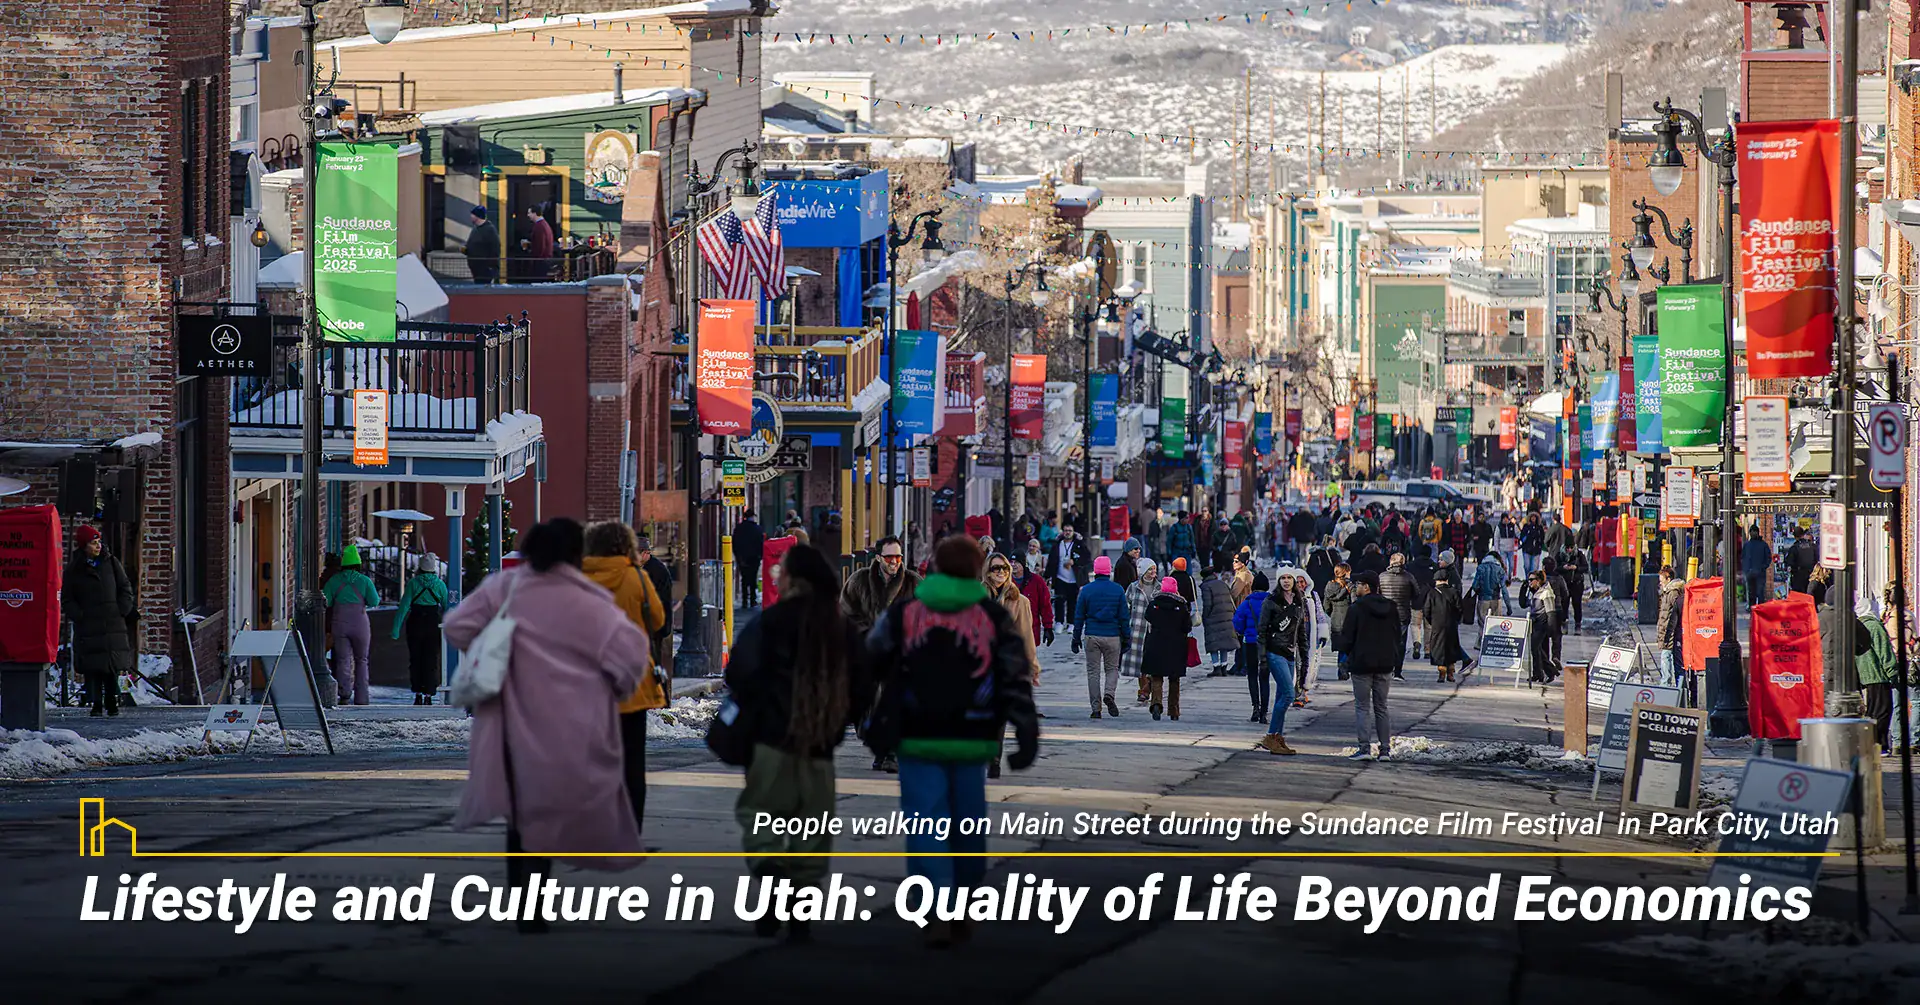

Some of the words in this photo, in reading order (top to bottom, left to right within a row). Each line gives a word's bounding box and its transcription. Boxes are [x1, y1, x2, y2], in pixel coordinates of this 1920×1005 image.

[1747, 139, 1783, 150] January
[325, 155, 354, 163] January
[1748, 150, 1785, 161] February
[1788, 150, 1797, 158] 2
[325, 164, 357, 173] February
[776, 204, 837, 219] ndieWire
[324, 216, 392, 229] Sundance
[1749, 218, 1831, 233] Sundance
[324, 231, 358, 242] Film
[1752, 237, 1796, 251] Film
[324, 245, 391, 257] Festival
[323, 259, 357, 271] 2025
[1752, 254, 1829, 270] Festival
[1753, 274, 1796, 288] 2025
[703, 349, 749, 359] Sundance
[1665, 348, 1720, 358] Sundance
[197, 360, 254, 368] AETHER
[703, 359, 727, 367] Film
[1665, 360, 1694, 369] Film
[703, 369, 748, 377] Festival
[1666, 371, 1720, 381] Festival
[702, 379, 726, 387] 2025
[1667, 383, 1694, 392] 2025
[10, 532, 22, 540] NO
[1, 570, 27, 578] EVENT
[1770, 644, 1800, 652] SPECIAL
[1640, 711, 1661, 721] OLD
[1664, 714, 1699, 726] TOWN
[1648, 723, 1688, 735] CELLARS
[1649, 740, 1667, 748] WINE
[1668, 742, 1682, 750] BAR
[1654, 752, 1675, 760] WINERY
